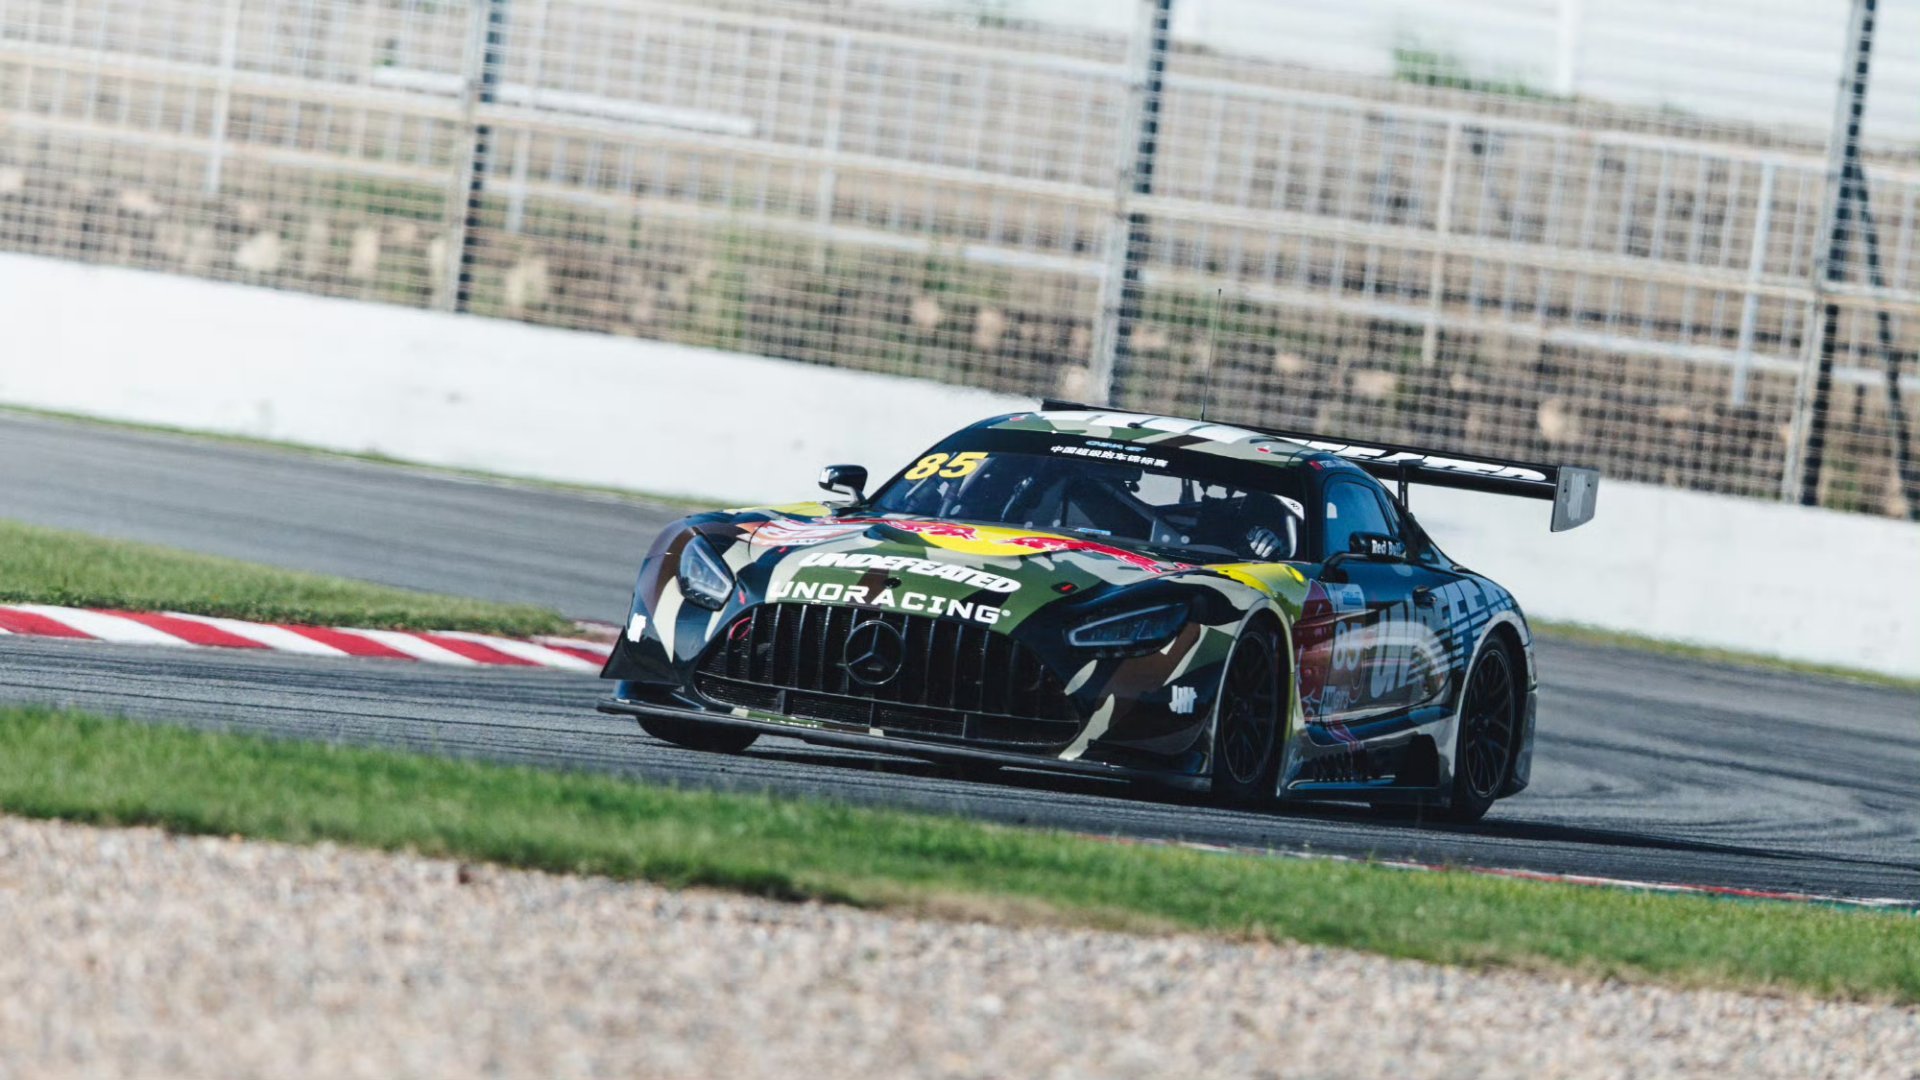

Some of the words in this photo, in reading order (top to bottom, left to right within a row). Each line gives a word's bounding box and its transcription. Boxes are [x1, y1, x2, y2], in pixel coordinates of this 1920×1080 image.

[904, 451, 989, 480] 85
[1371, 539, 1387, 554] Red
[800, 552, 1022, 593] UNDEFEATED
